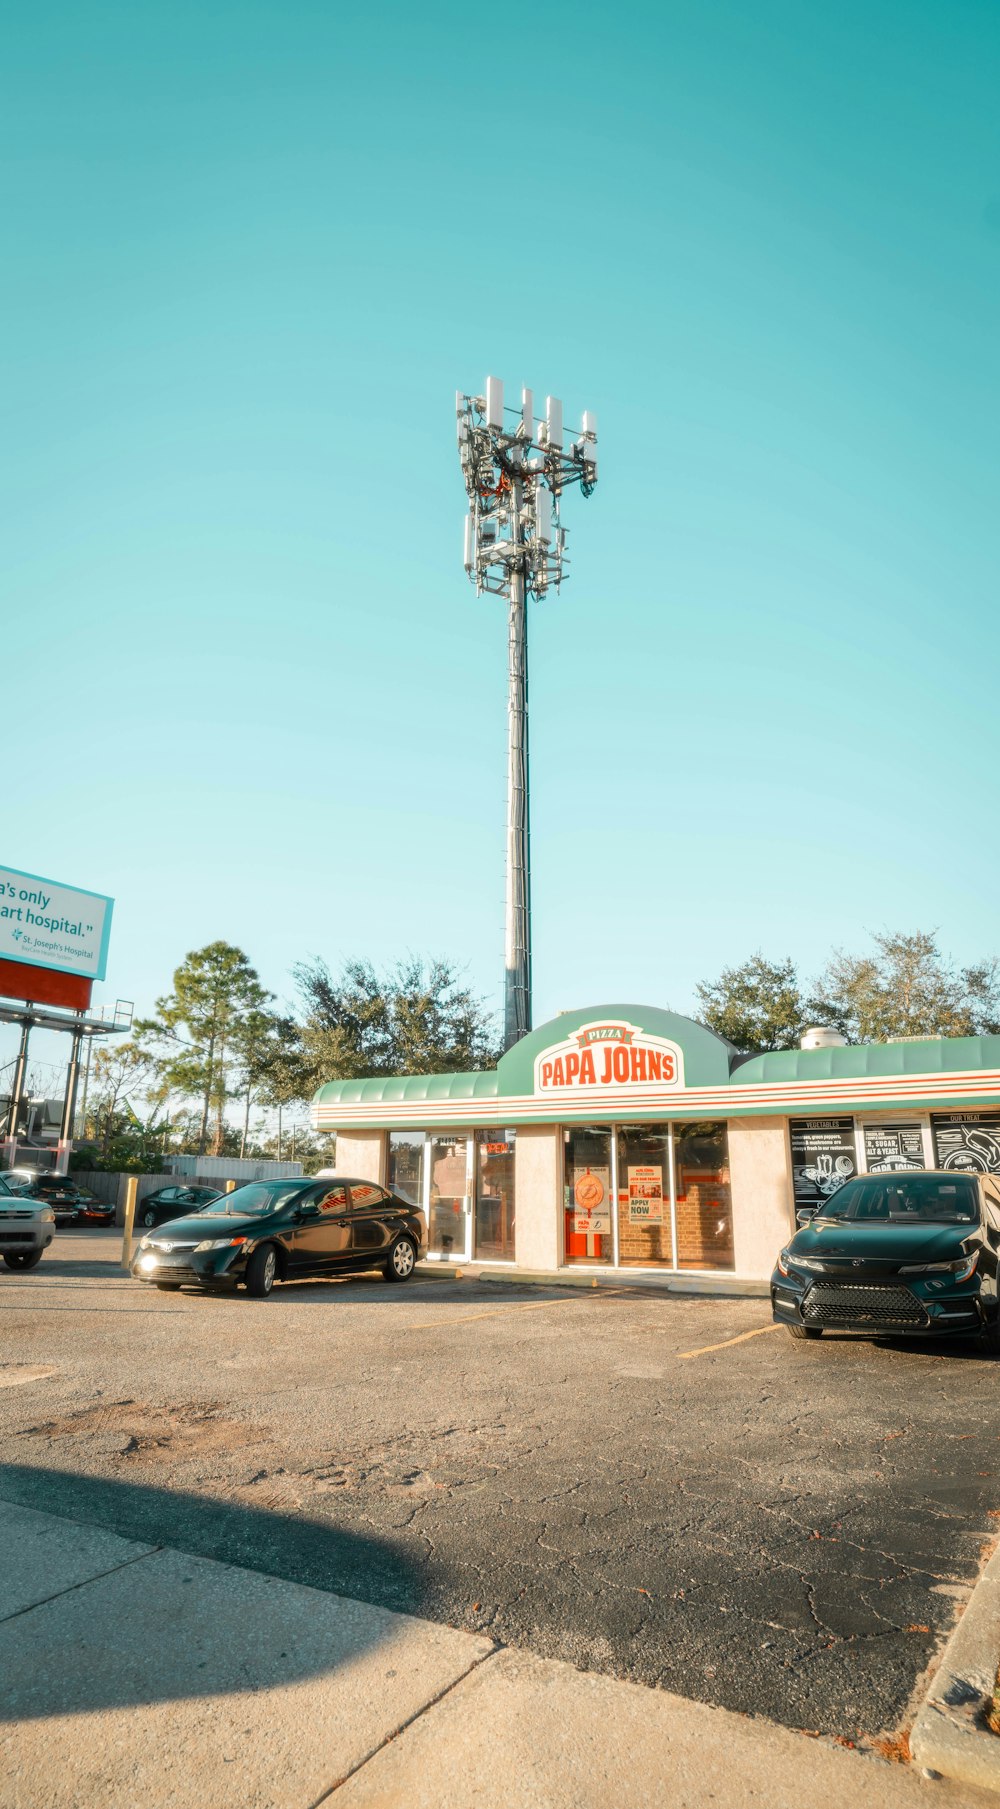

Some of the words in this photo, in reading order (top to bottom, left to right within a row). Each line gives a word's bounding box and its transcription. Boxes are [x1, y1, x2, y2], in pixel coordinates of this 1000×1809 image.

[19, 890, 50, 910] only
[0, 905, 23, 922] art
[25, 909, 93, 937] hospital."
[23, 935, 33, 945] St.
[33, 938, 63, 952] Joseph's
[64, 945, 94, 959] Hospital
[588, 1029, 622, 1041] PIZZA
[542, 1049, 597, 1087] PAPA
[486, 1142, 509, 1154] OPEN
[875, 1140, 898, 1148] SUGAR,
[882, 1147, 899, 1155] YEAST
[630, 1206, 650, 1214] NOW
